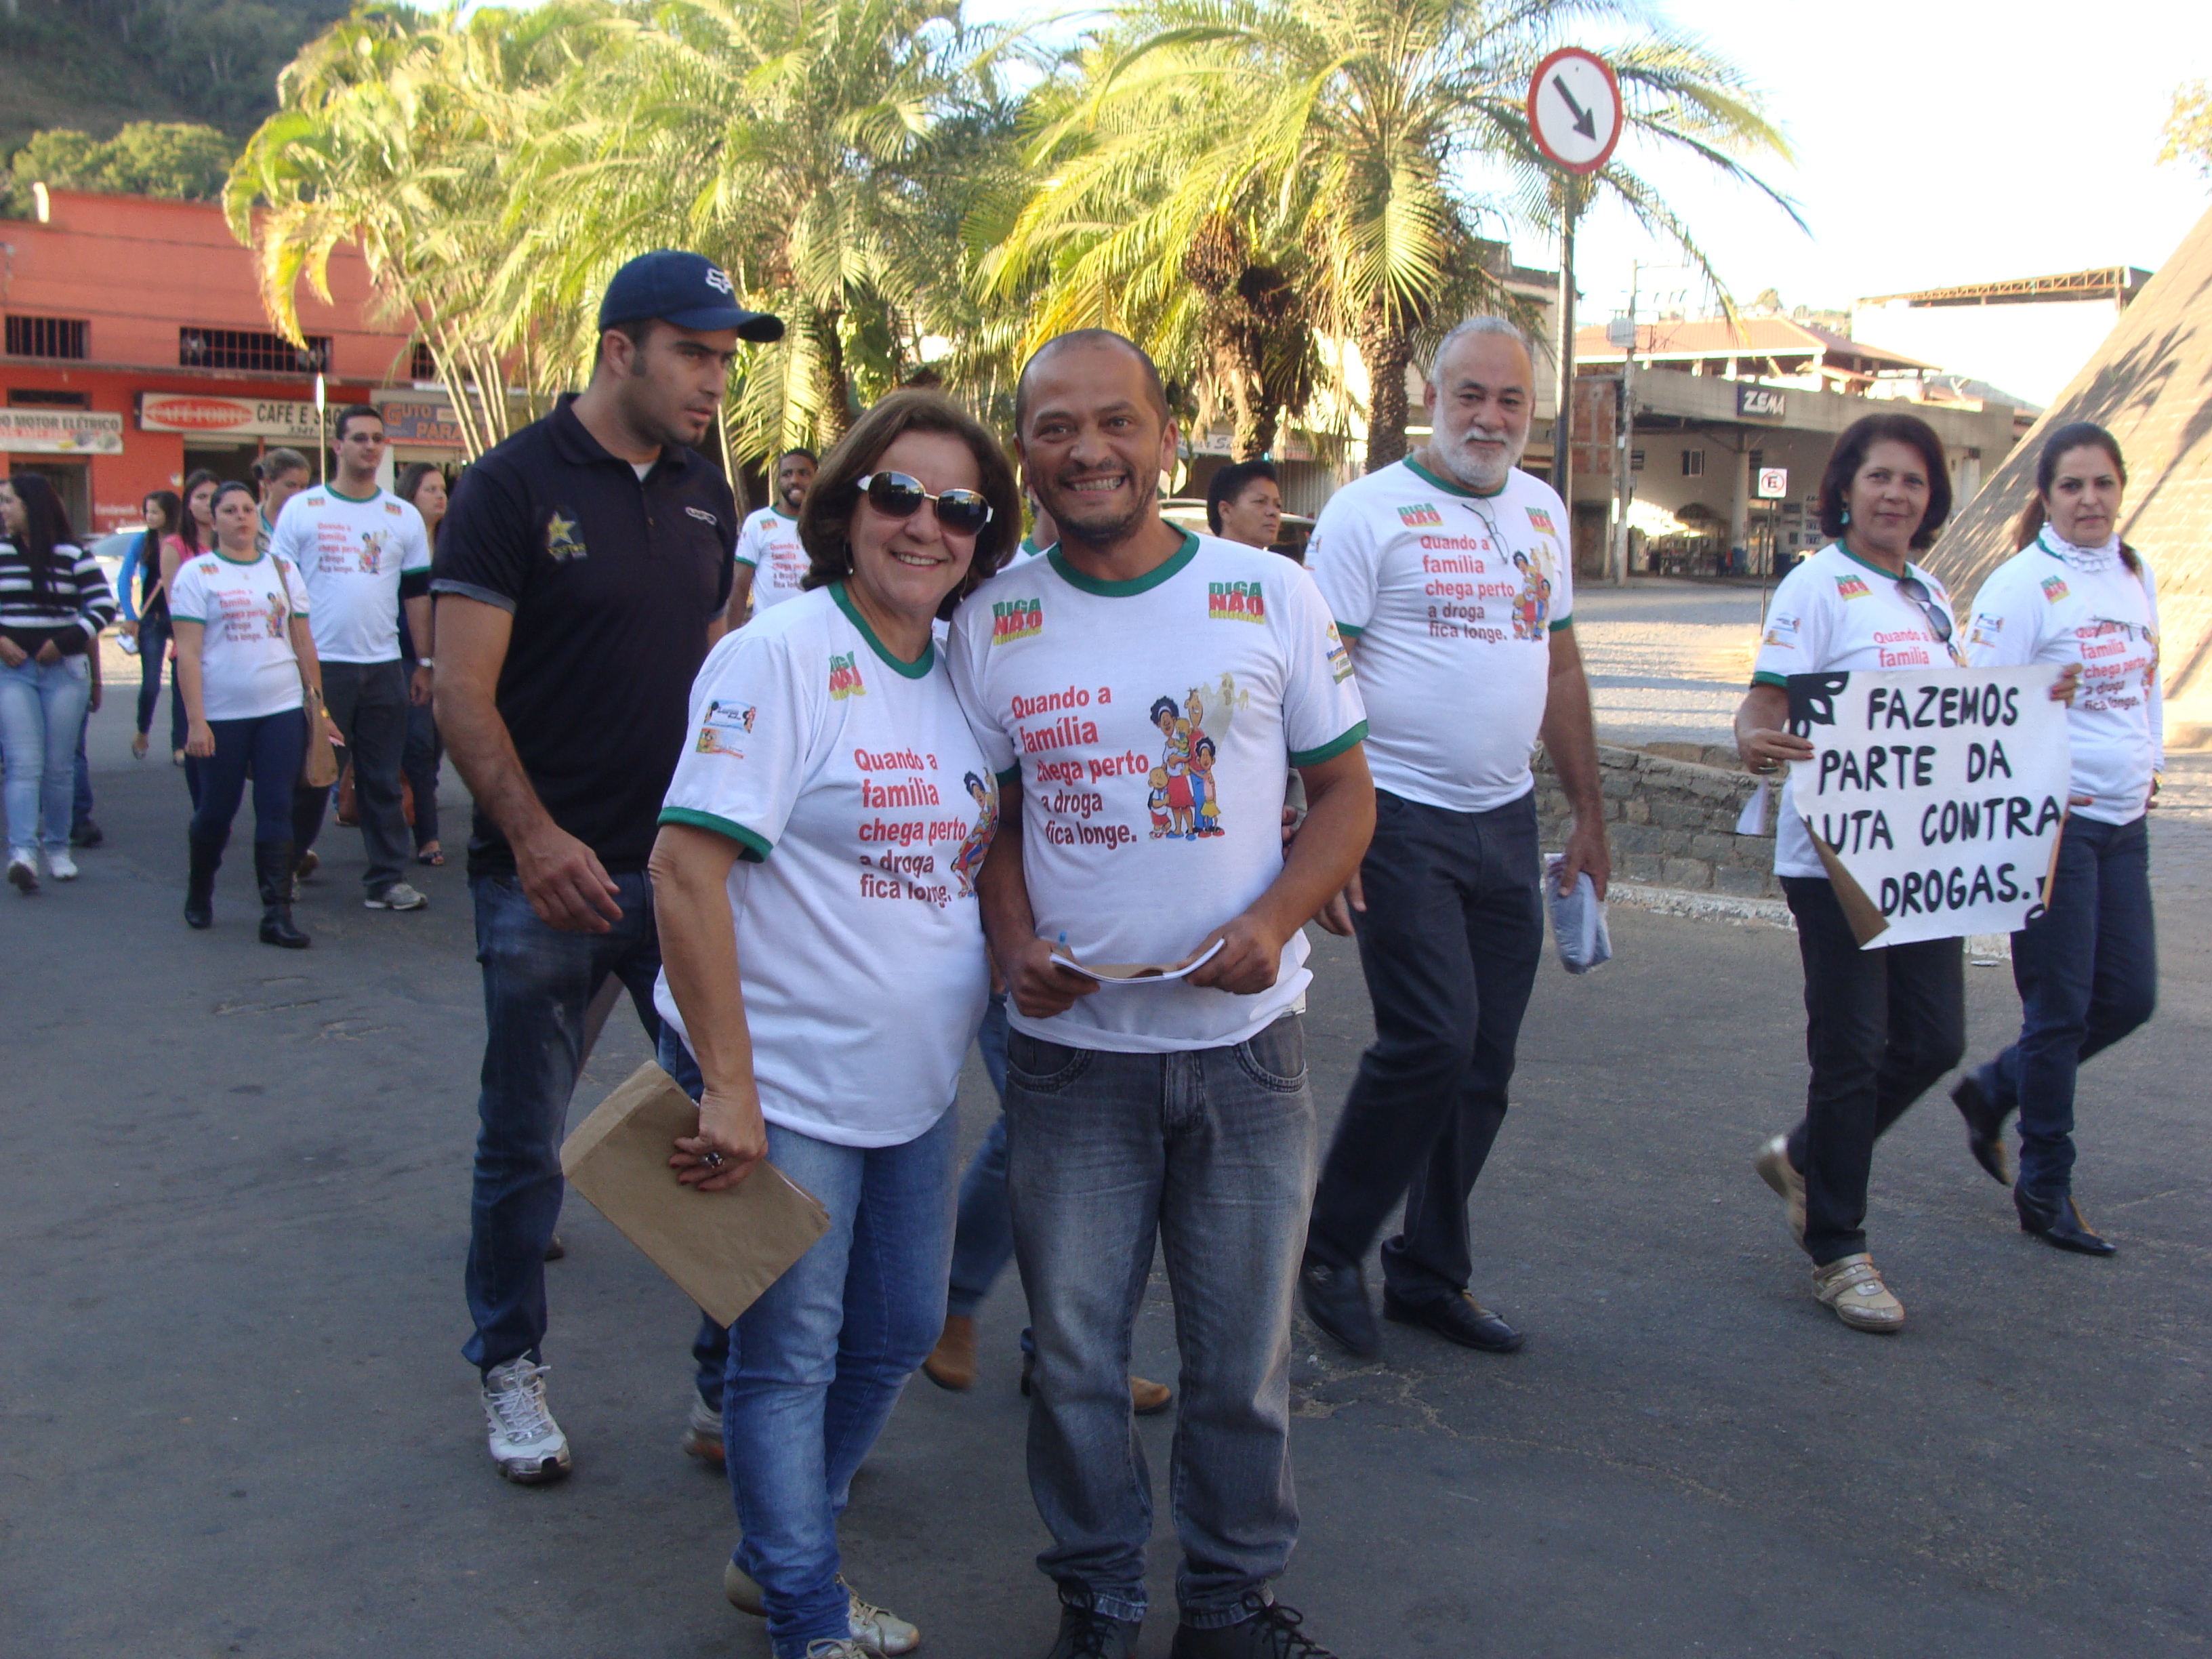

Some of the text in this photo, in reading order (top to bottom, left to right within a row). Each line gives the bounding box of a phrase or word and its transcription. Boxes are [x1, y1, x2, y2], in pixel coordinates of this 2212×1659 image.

[257, 401, 293, 424] CAFÉ
[300, 405, 308, 424] E
[383, 402, 432, 426] GUTO
[1744, 390, 1785, 416] ZEMA
[14, 415, 59, 428] MOTOR
[1767, 476, 1778, 488] E
[1400, 510, 1442, 527] NÃO
[1420, 534, 1490, 551] Quando a
[1422, 554, 1486, 574] família
[1208, 581, 1263, 597] DIGA
[1425, 578, 1515, 600] chega perto
[992, 598, 1042, 618] DIGA
[1208, 590, 1264, 616] NÃO
[1428, 601, 1485, 623] a droga
[993, 609, 1043, 636] NÃO
[1429, 620, 1508, 644] fica longe.
[1873, 628, 1929, 644] Quando a
[1879, 646, 1930, 668] família
[2083, 663, 2122, 680] chega
[1011, 685, 1111, 720] Quando a
[1867, 682, 2020, 731] FAZEMOS
[1019, 716, 1099, 754] família
[854, 747, 939, 773] Quando a
[1088, 748, 1149, 785] perto
[1818, 739, 2013, 796] PARTE DA
[861, 777, 940, 808] família
[1040, 788, 1103, 820] a droga
[859, 816, 967, 848] chega perto
[1045, 820, 1137, 851] fica longe.
[1807, 794, 2062, 855] UTA CONTRA
[879, 848, 935, 878] droga
[860, 874, 901, 900] fica
[1881, 863, 2031, 918] DROGAS.
